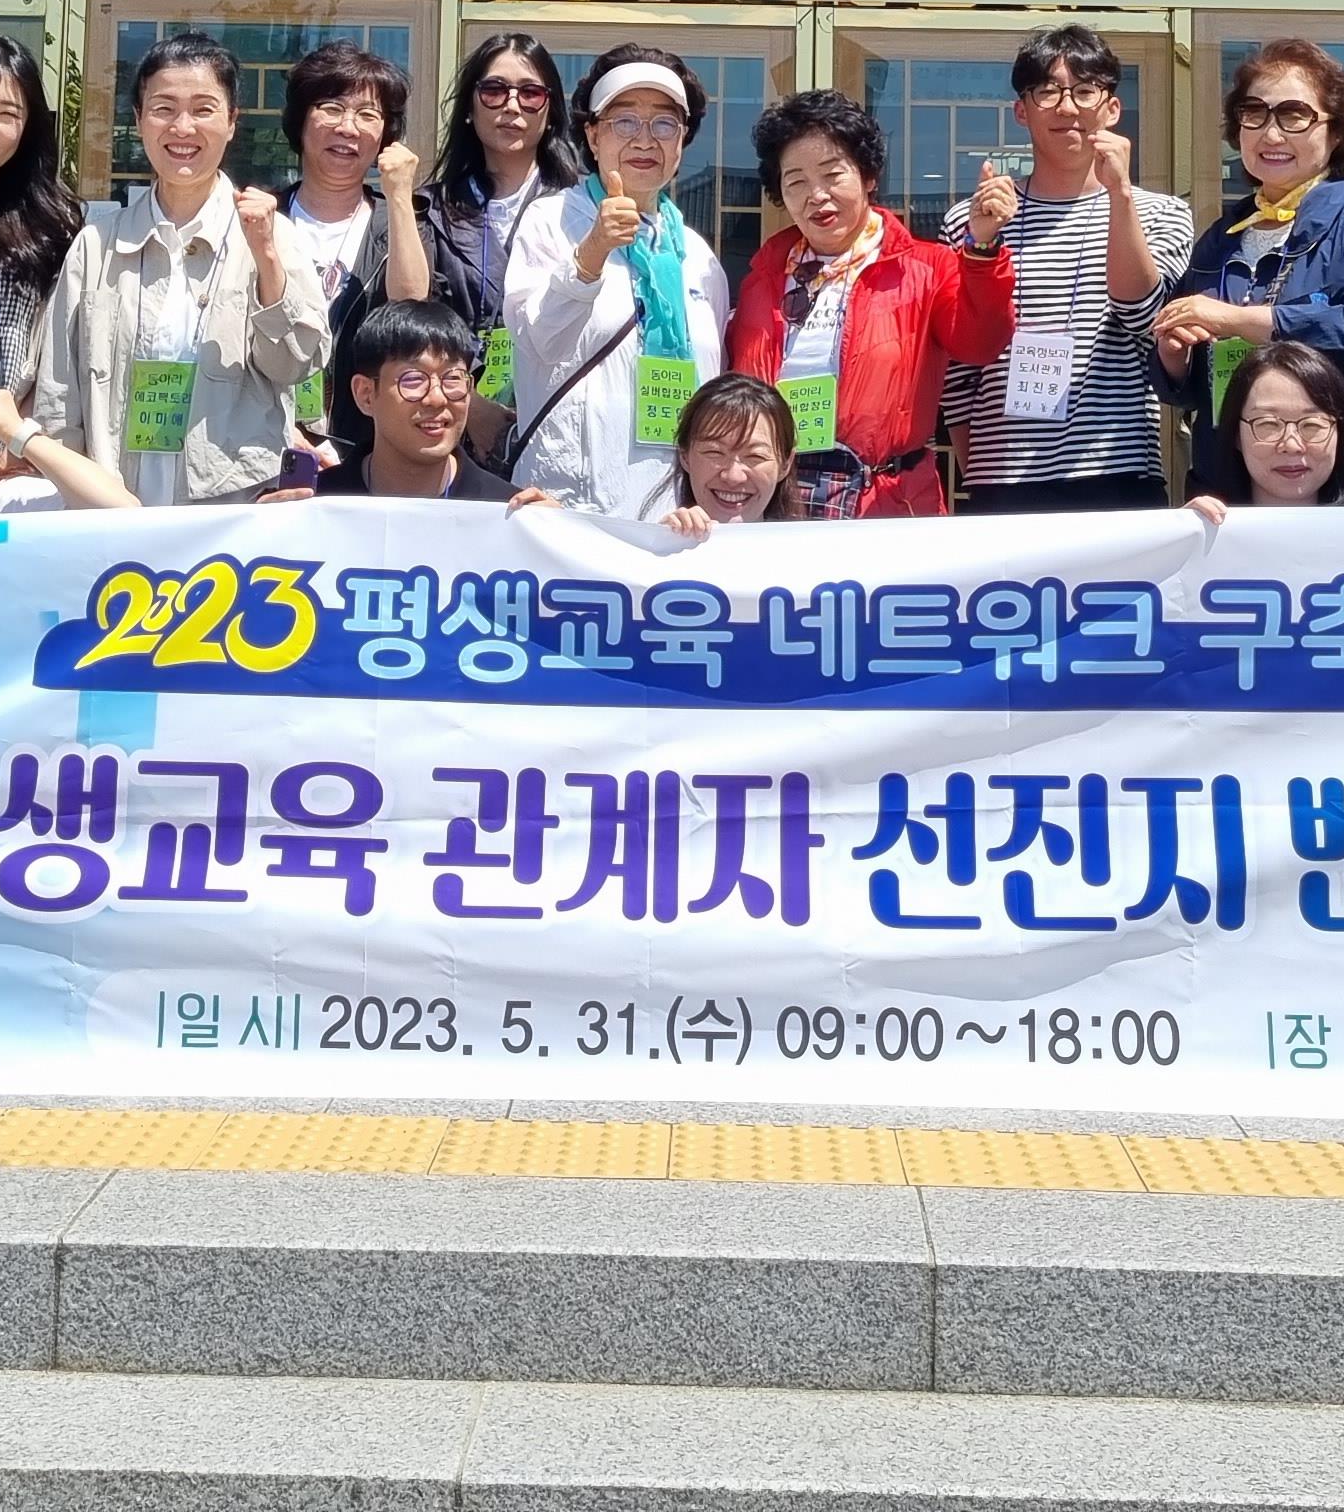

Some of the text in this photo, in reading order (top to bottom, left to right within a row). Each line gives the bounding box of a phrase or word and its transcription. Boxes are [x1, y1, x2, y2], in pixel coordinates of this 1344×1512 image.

[71, 561, 318, 674] 2023
[340, 573, 730, 688] 평생교육
[766, 580, 1167, 686] 네트워크
[421, 764, 826, 928] 관계자
[851, 771, 1248, 934] 선진지
[319, 994, 474, 1056] 2023.
[501, 1000, 550, 1057] 5.
[576, 995, 753, 1066] 31.(수)
